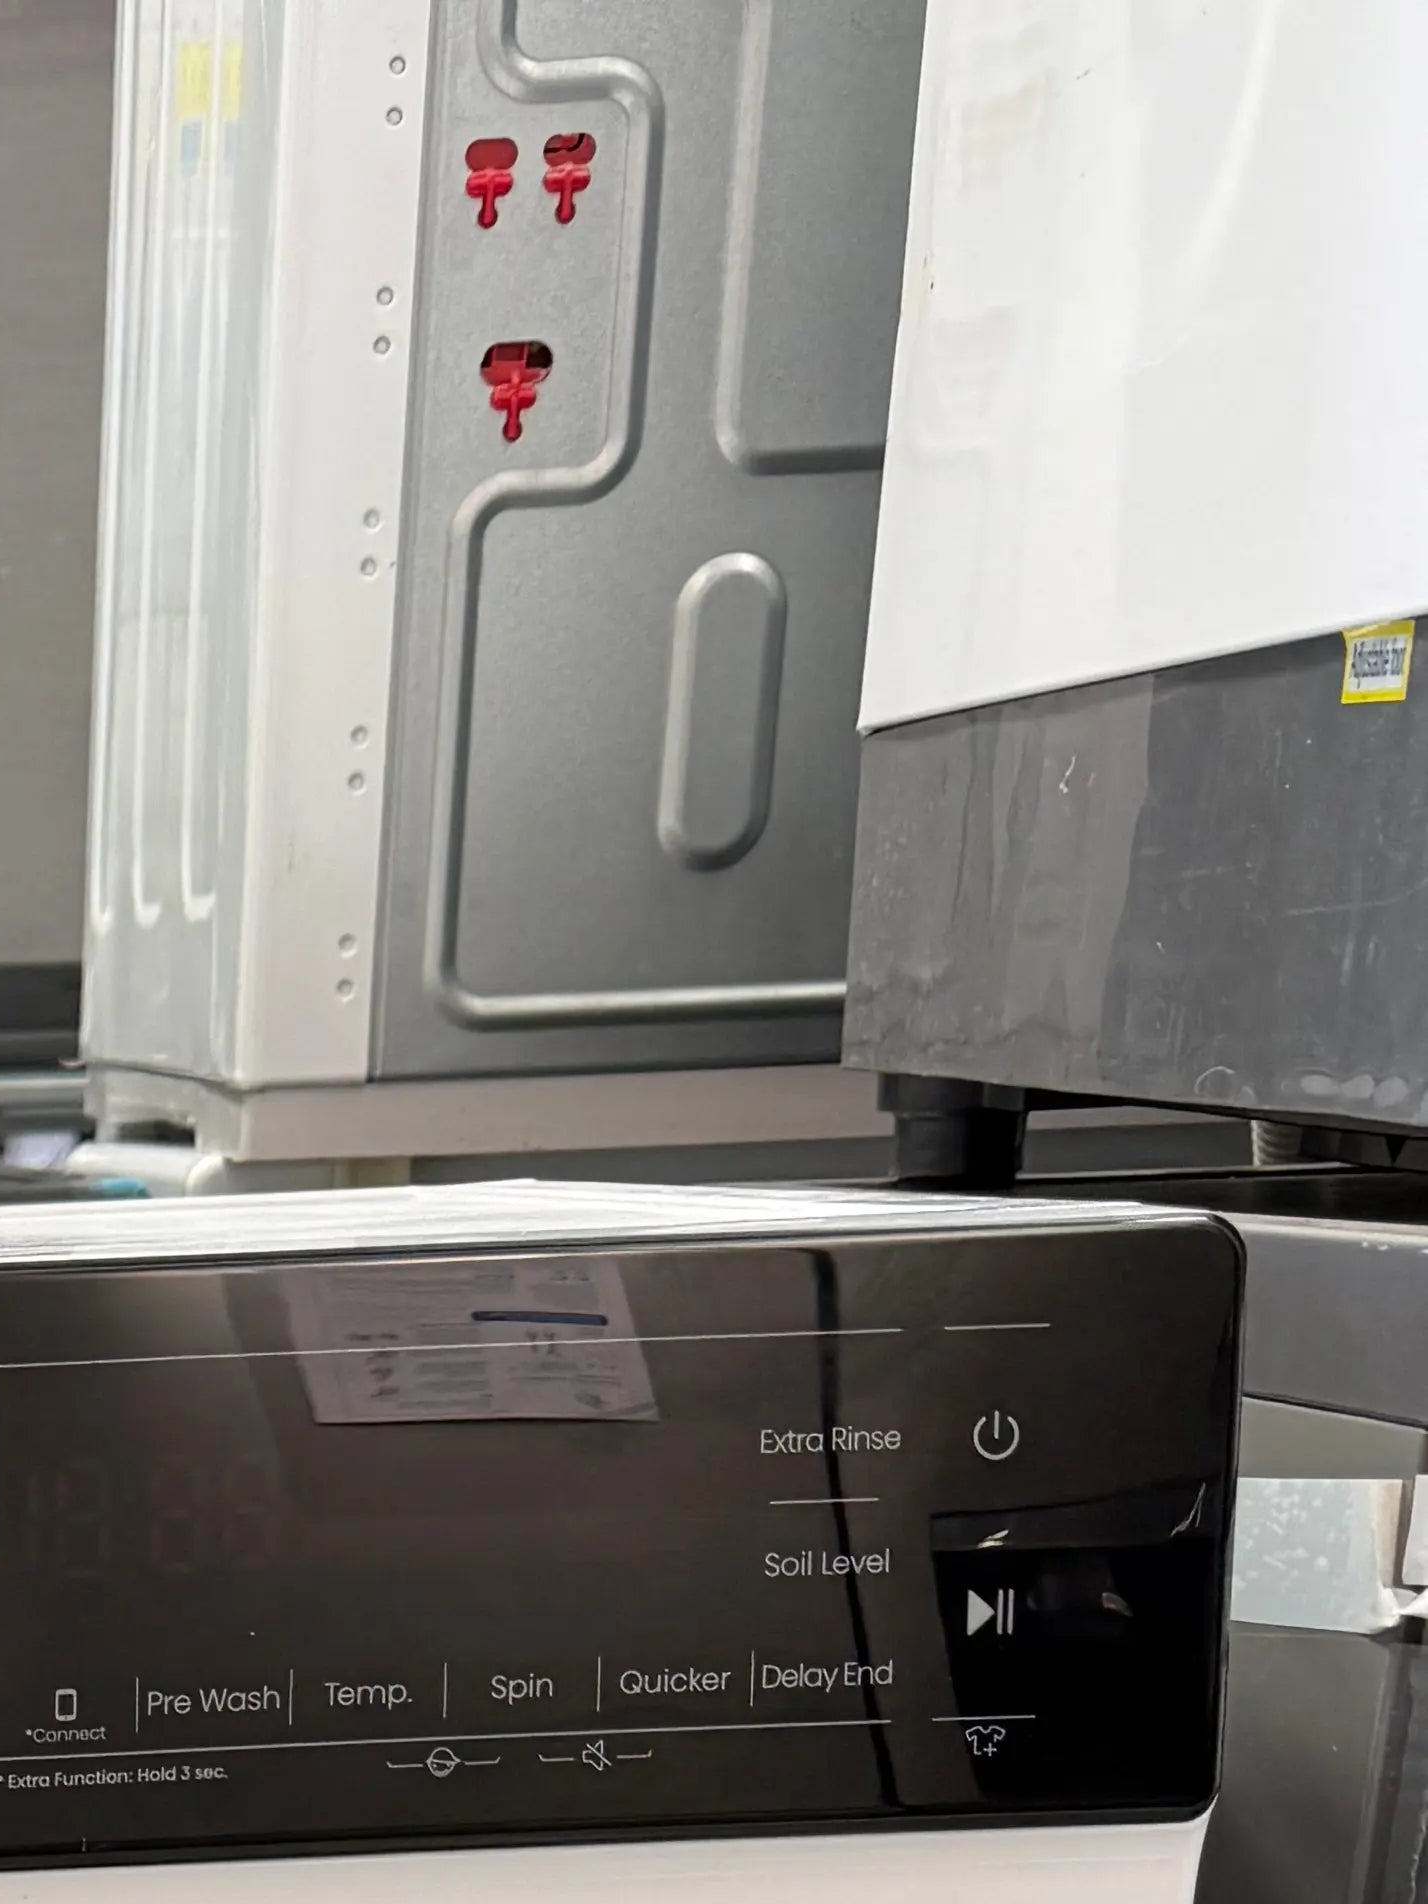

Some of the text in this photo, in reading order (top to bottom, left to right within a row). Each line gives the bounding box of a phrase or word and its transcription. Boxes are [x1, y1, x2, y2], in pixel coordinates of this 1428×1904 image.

[760, 1427, 901, 1454] Extra Rinse
[764, 1549, 890, 1578] Soil Level
[491, 1674, 552, 1705] Spin
[619, 1669, 731, 1697] Quicker
[762, 1660, 893, 1693] Delay End
[148, 1685, 280, 1716] Pre Wash
[325, 1682, 412, 1708] Temp.
[55, 1769, 133, 1786] Function:
[137, 1767, 176, 1782] Hold
[181, 1767, 191, 1781] 3
[195, 1768, 227, 1780] sec.
